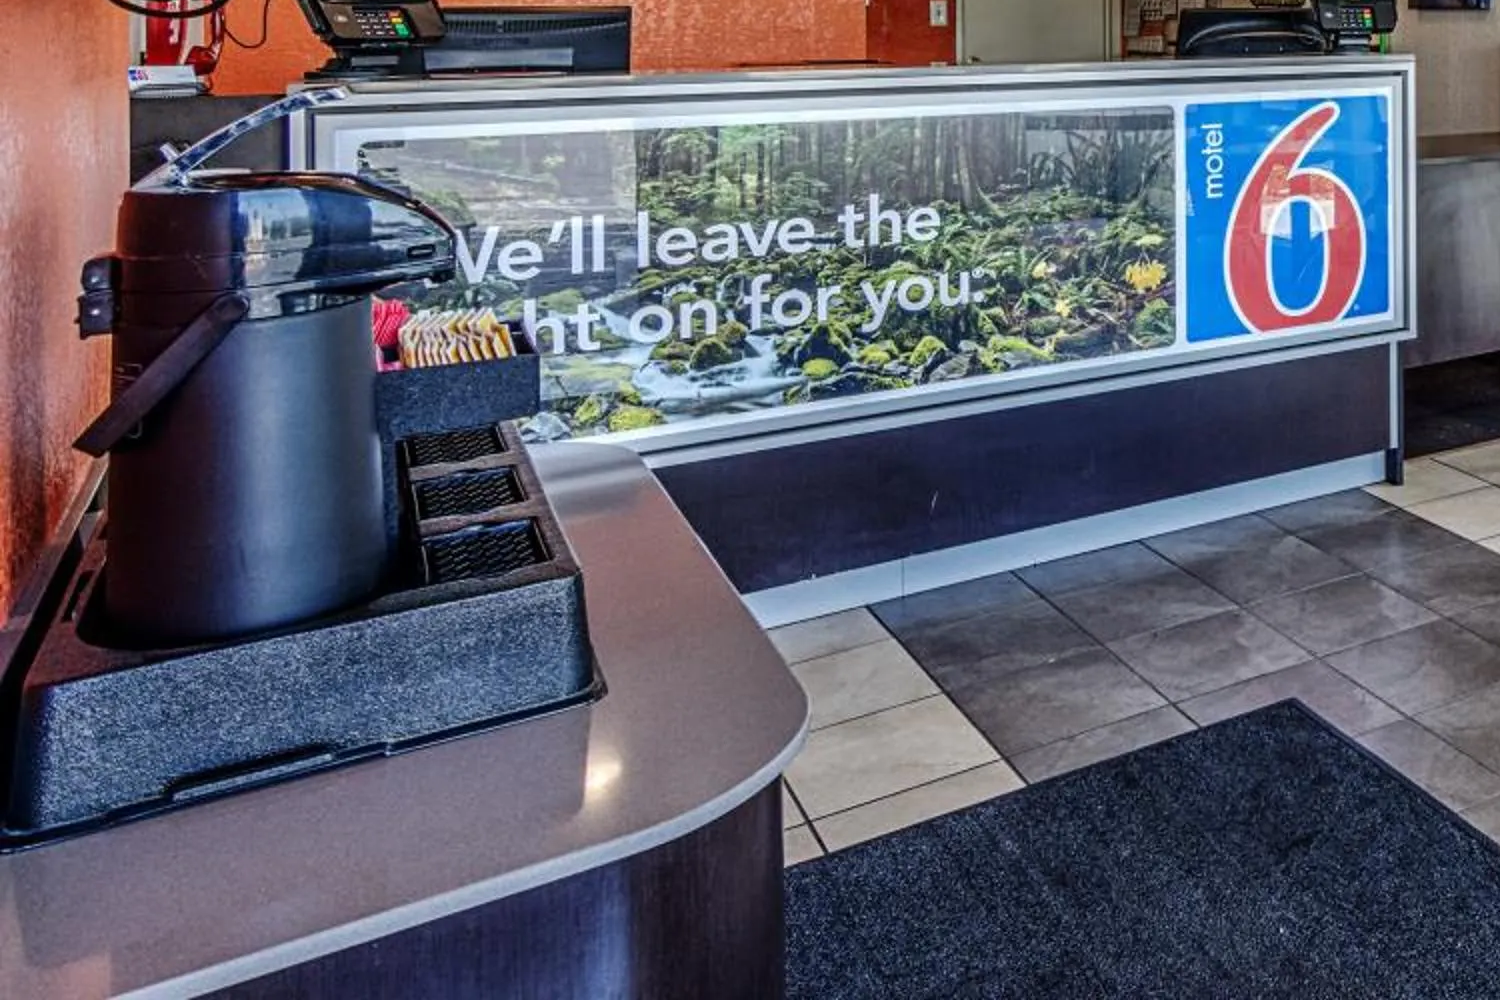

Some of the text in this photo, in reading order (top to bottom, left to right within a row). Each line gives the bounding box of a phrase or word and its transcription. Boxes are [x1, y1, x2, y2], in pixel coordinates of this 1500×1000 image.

[1201, 123, 1224, 199] motel
[637, 211, 815, 268] leave
[837, 194, 941, 248] the
[1223, 100, 1367, 335] 6
[628, 300, 717, 344] on
[743, 273, 842, 331] for
